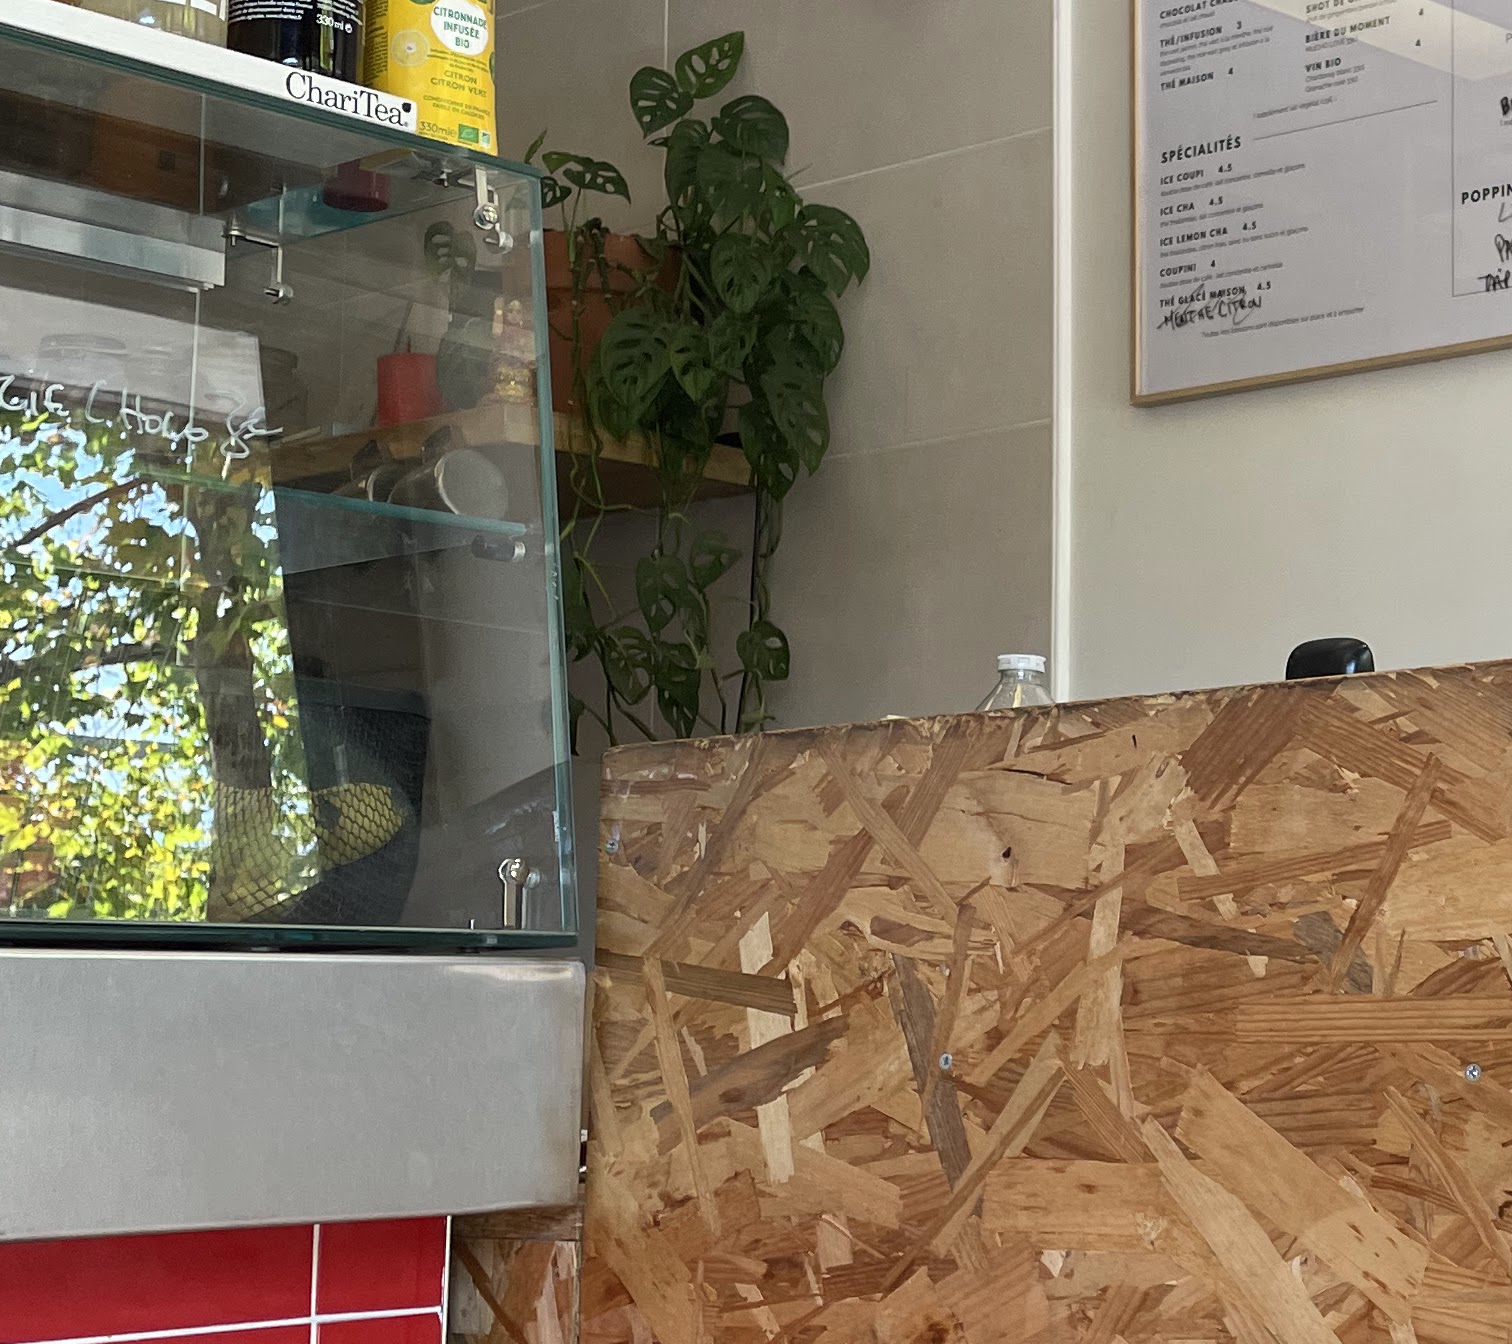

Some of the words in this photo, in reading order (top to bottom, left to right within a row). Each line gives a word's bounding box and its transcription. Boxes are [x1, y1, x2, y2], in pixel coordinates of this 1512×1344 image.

[433, 6, 487, 30] CITRONNADE
[444, 20, 480, 40] INFUSÉE
[455, 37, 470, 49] BIO
[444, 70, 477, 85] CITRON
[286, 71, 404, 127] ChariTea
[1161, 135, 1241, 164] SPÉCIALITÉS
[1160, 237, 1173, 246] ICE
[1176, 230, 1206, 244] LEMON
[1210, 226, 1228, 238] CHA
[1243, 221, 1256, 230] 4.5
